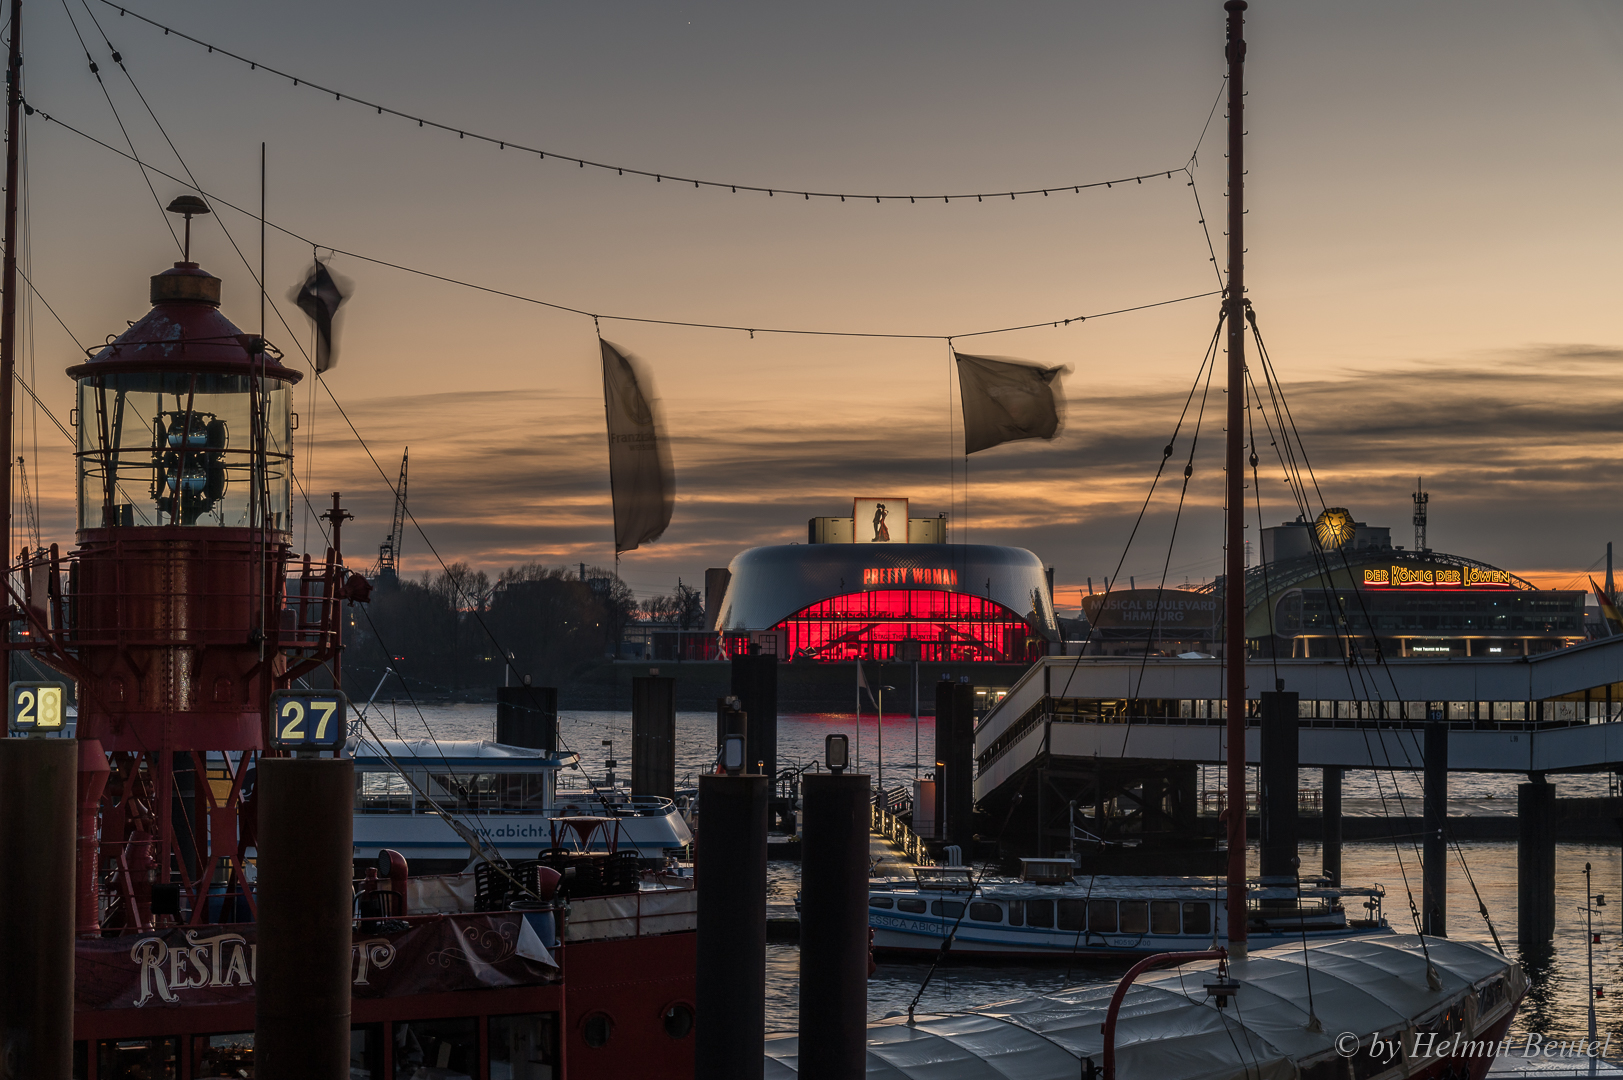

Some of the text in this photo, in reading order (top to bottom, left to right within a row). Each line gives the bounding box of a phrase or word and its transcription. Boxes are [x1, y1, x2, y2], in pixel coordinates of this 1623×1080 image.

[863, 568, 958, 585] PRETTY WOMAN
[1364, 566, 1510, 586] DER KÖNIG DER LÖWEN
[1090, 599, 1217, 611] MUSICAL BOULEVARD
[1122, 611, 1185, 621] HAMBURG
[17, 690, 58, 722] 28
[1431, 711, 1442, 720] 19
[281, 701, 337, 739] 27
[869, 914, 951, 935] ESSICA ABICHT
[131, 929, 397, 1009] RESTAT
